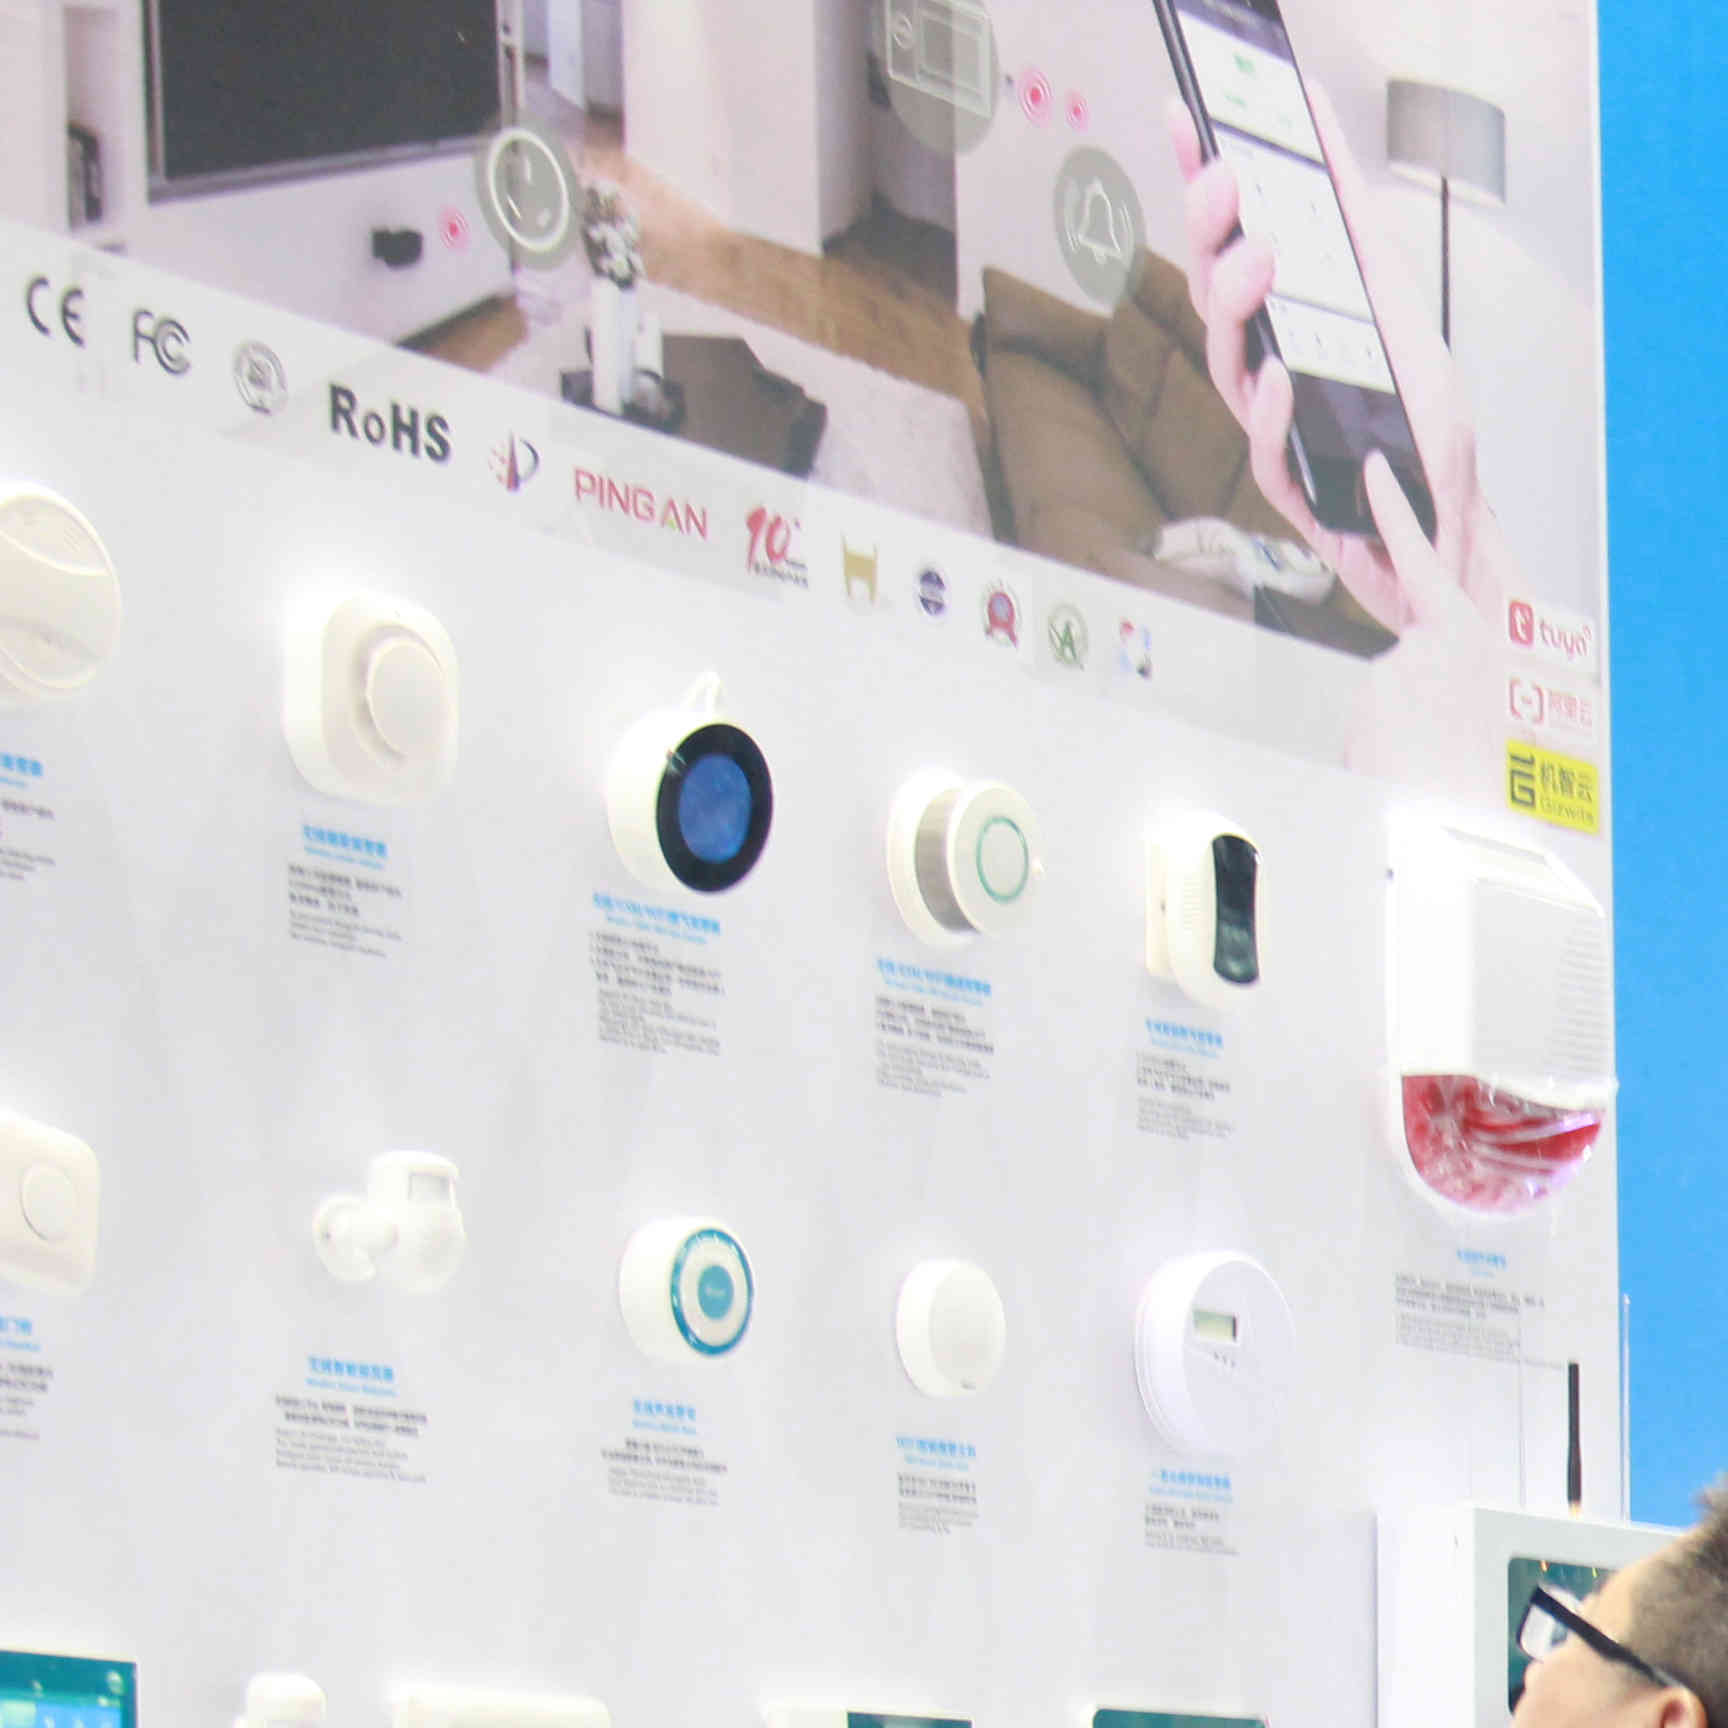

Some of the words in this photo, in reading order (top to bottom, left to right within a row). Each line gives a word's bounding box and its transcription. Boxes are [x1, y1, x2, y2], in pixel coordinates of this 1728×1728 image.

[27, 276, 85, 346] CE
[328, 383, 452, 464] RoHS
[574, 467, 709, 541] PINGAN
[1541, 762, 1593, 803] 机智云
